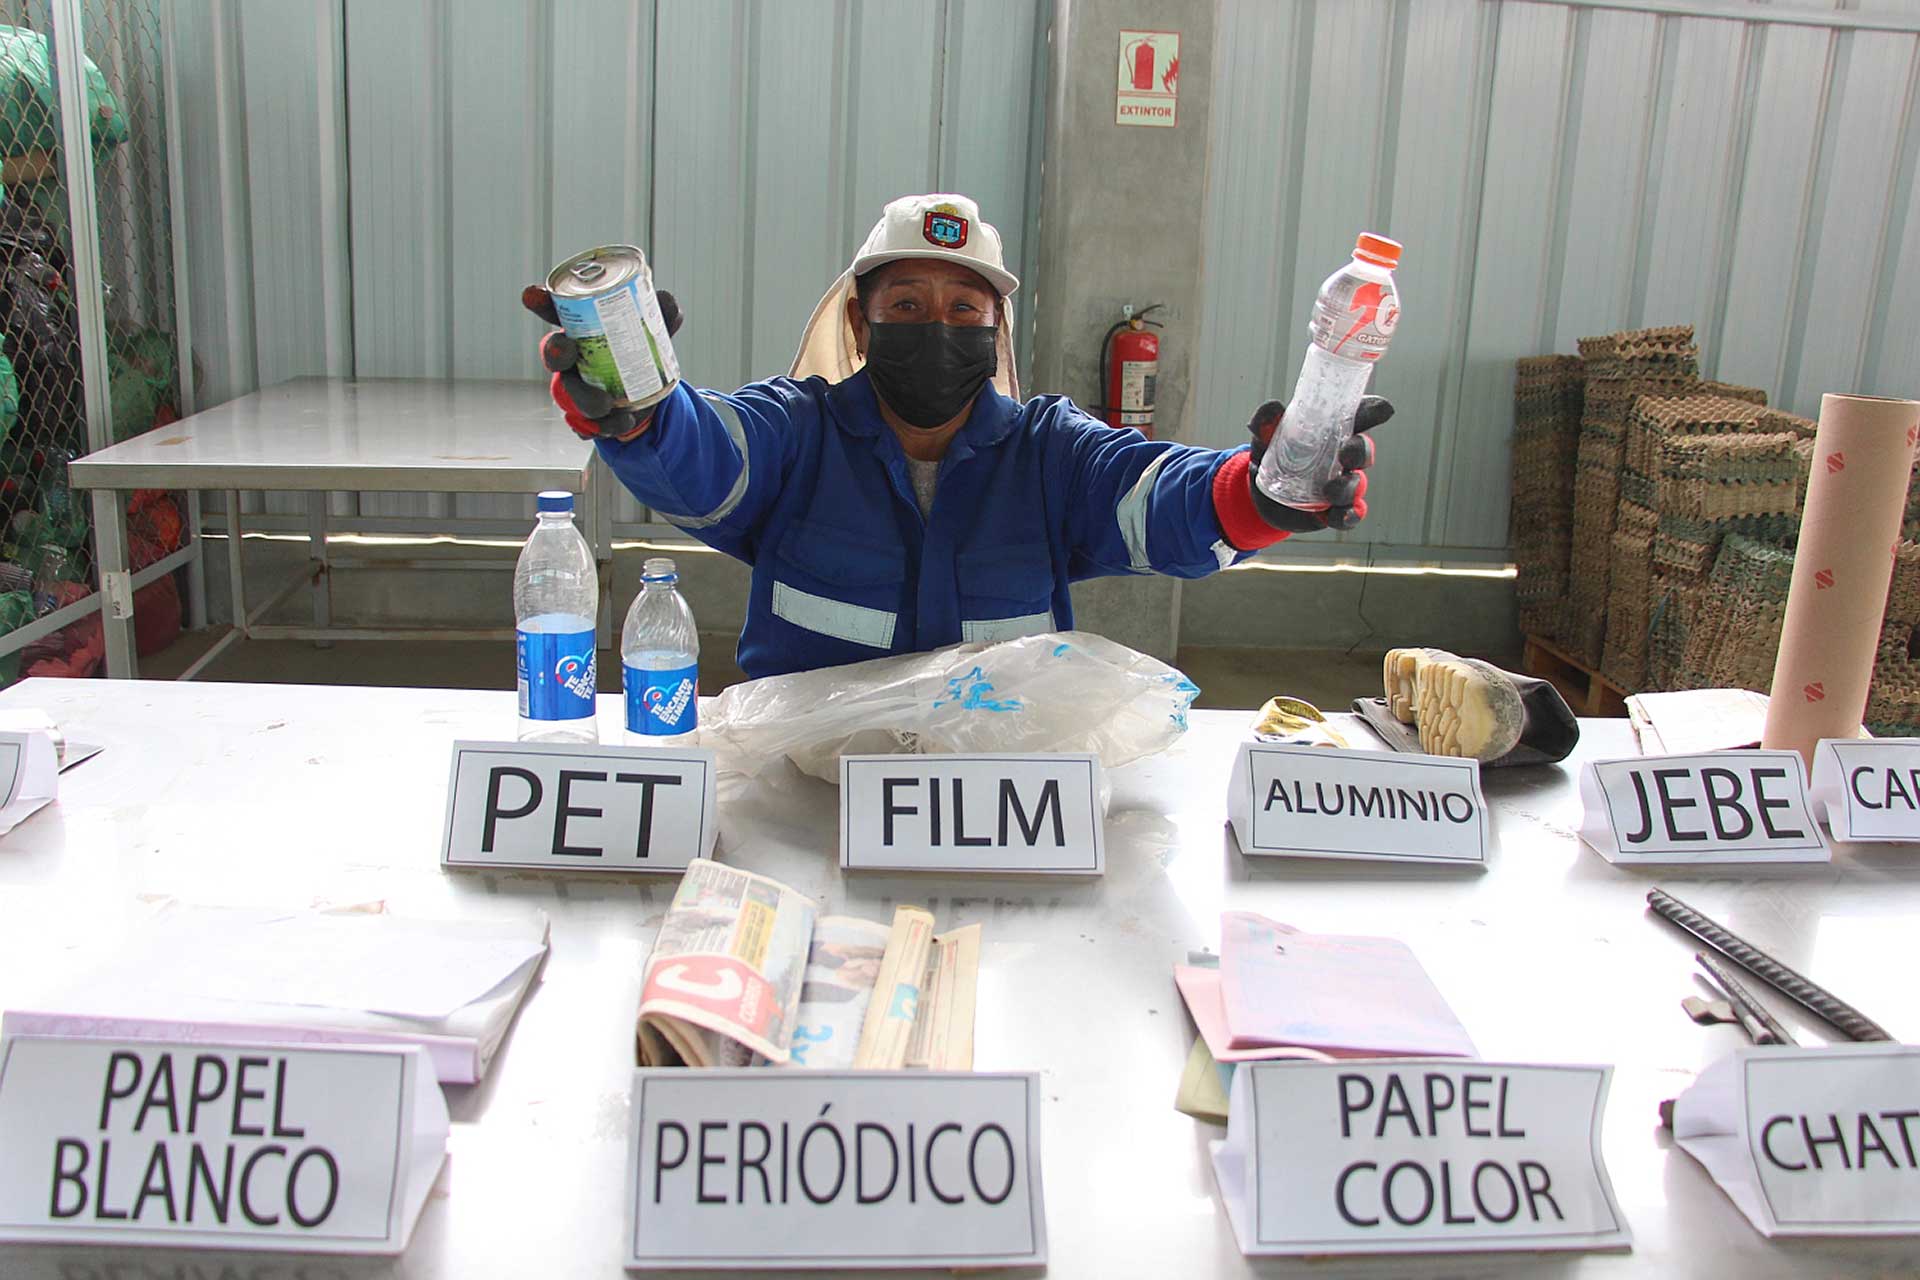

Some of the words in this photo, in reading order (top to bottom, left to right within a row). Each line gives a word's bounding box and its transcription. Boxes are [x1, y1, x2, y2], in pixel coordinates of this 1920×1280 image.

[1120, 105, 1172, 117] EXTINTOR
[564, 675, 580, 689] TE
[651, 703, 665, 716] TE
[481, 766, 683, 859] PET
[882, 777, 1066, 847] FILM
[1263, 778, 1474, 824] ALUMINIO
[1626, 767, 1805, 844] JEBE
[98, 1051, 305, 1138] PAPEL
[1337, 1073, 1526, 1138] PAPEL
[655, 1103, 1016, 1205] PERIÓDICO
[1760, 1109, 1920, 1172] CHAT
[50, 1137, 340, 1228] BLANCO
[1335, 1160, 1565, 1227] COLOR
